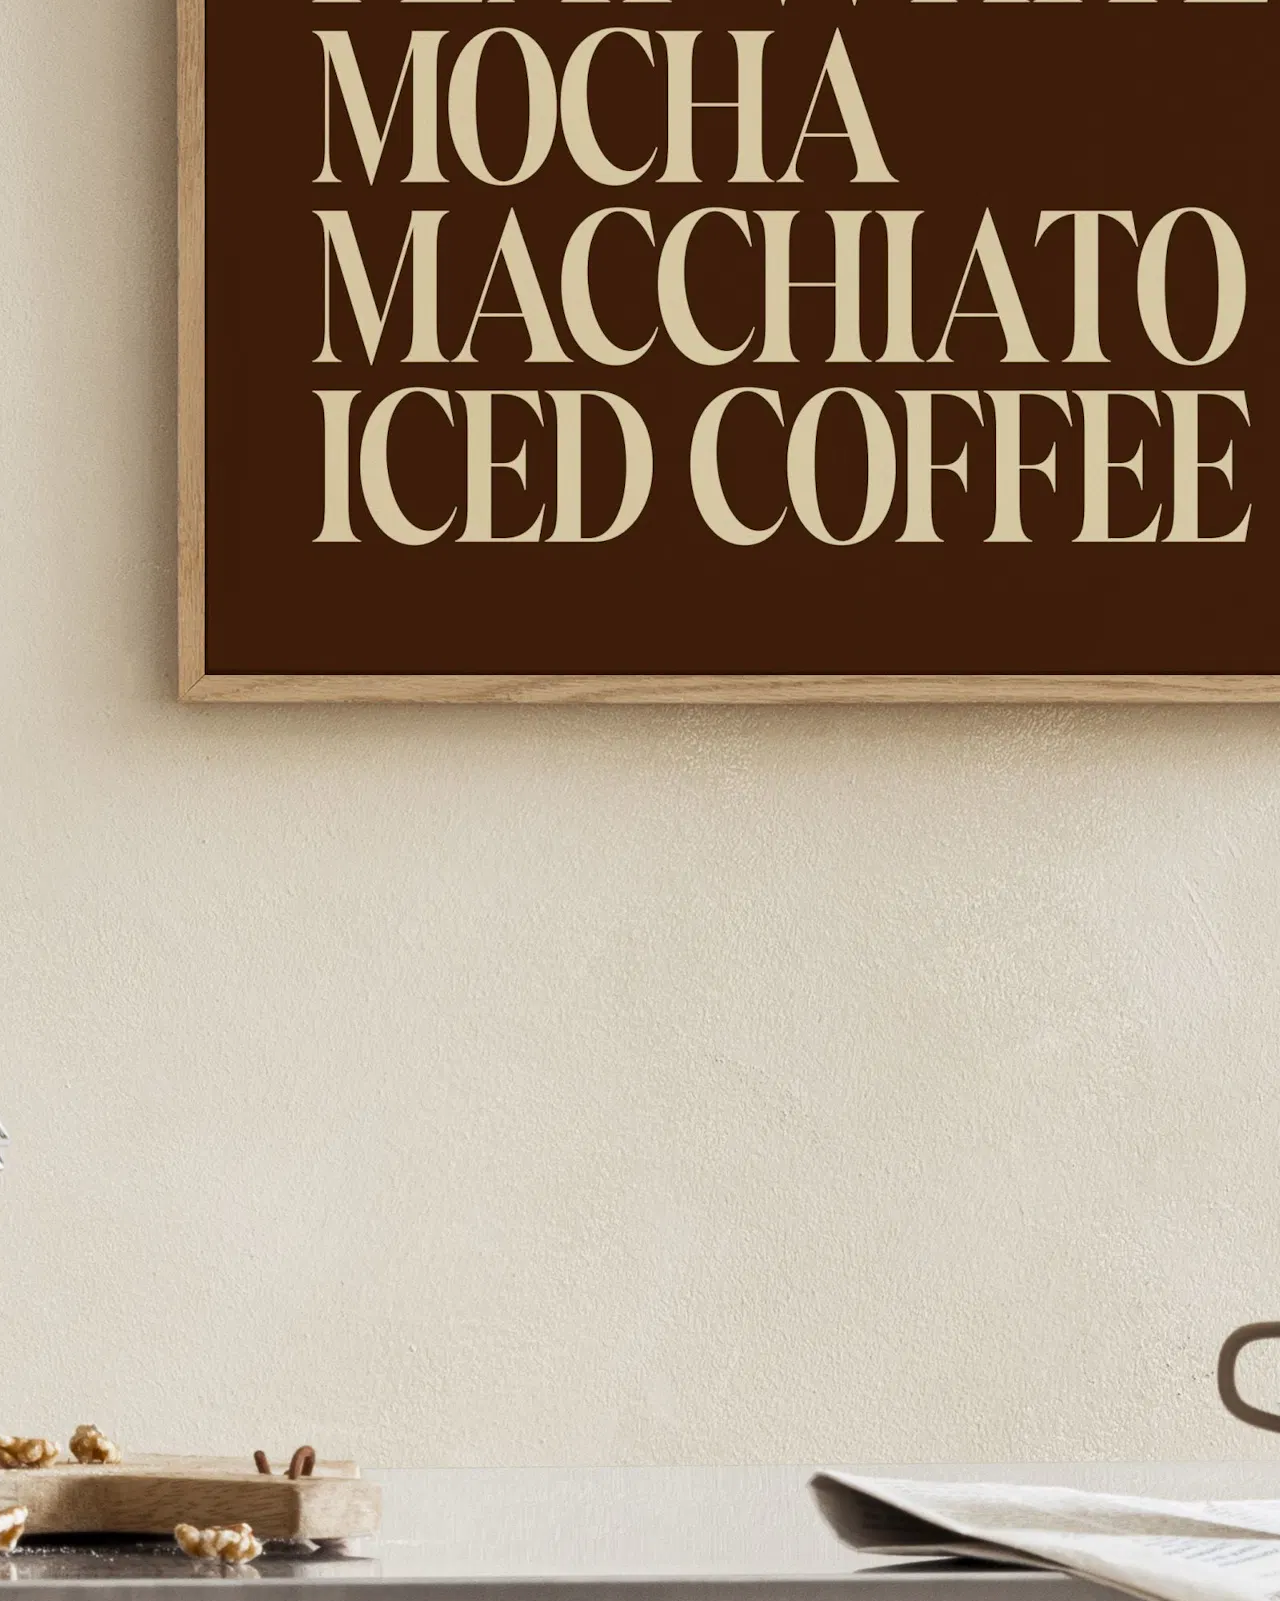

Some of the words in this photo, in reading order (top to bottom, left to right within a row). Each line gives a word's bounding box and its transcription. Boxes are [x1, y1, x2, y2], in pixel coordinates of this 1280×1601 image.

[312, 27, 900, 186] MOCHA
[312, 206, 1247, 366] MACCHIATO
[311, 386, 654, 546] ICED
[689, 386, 1252, 546] COFFEE
